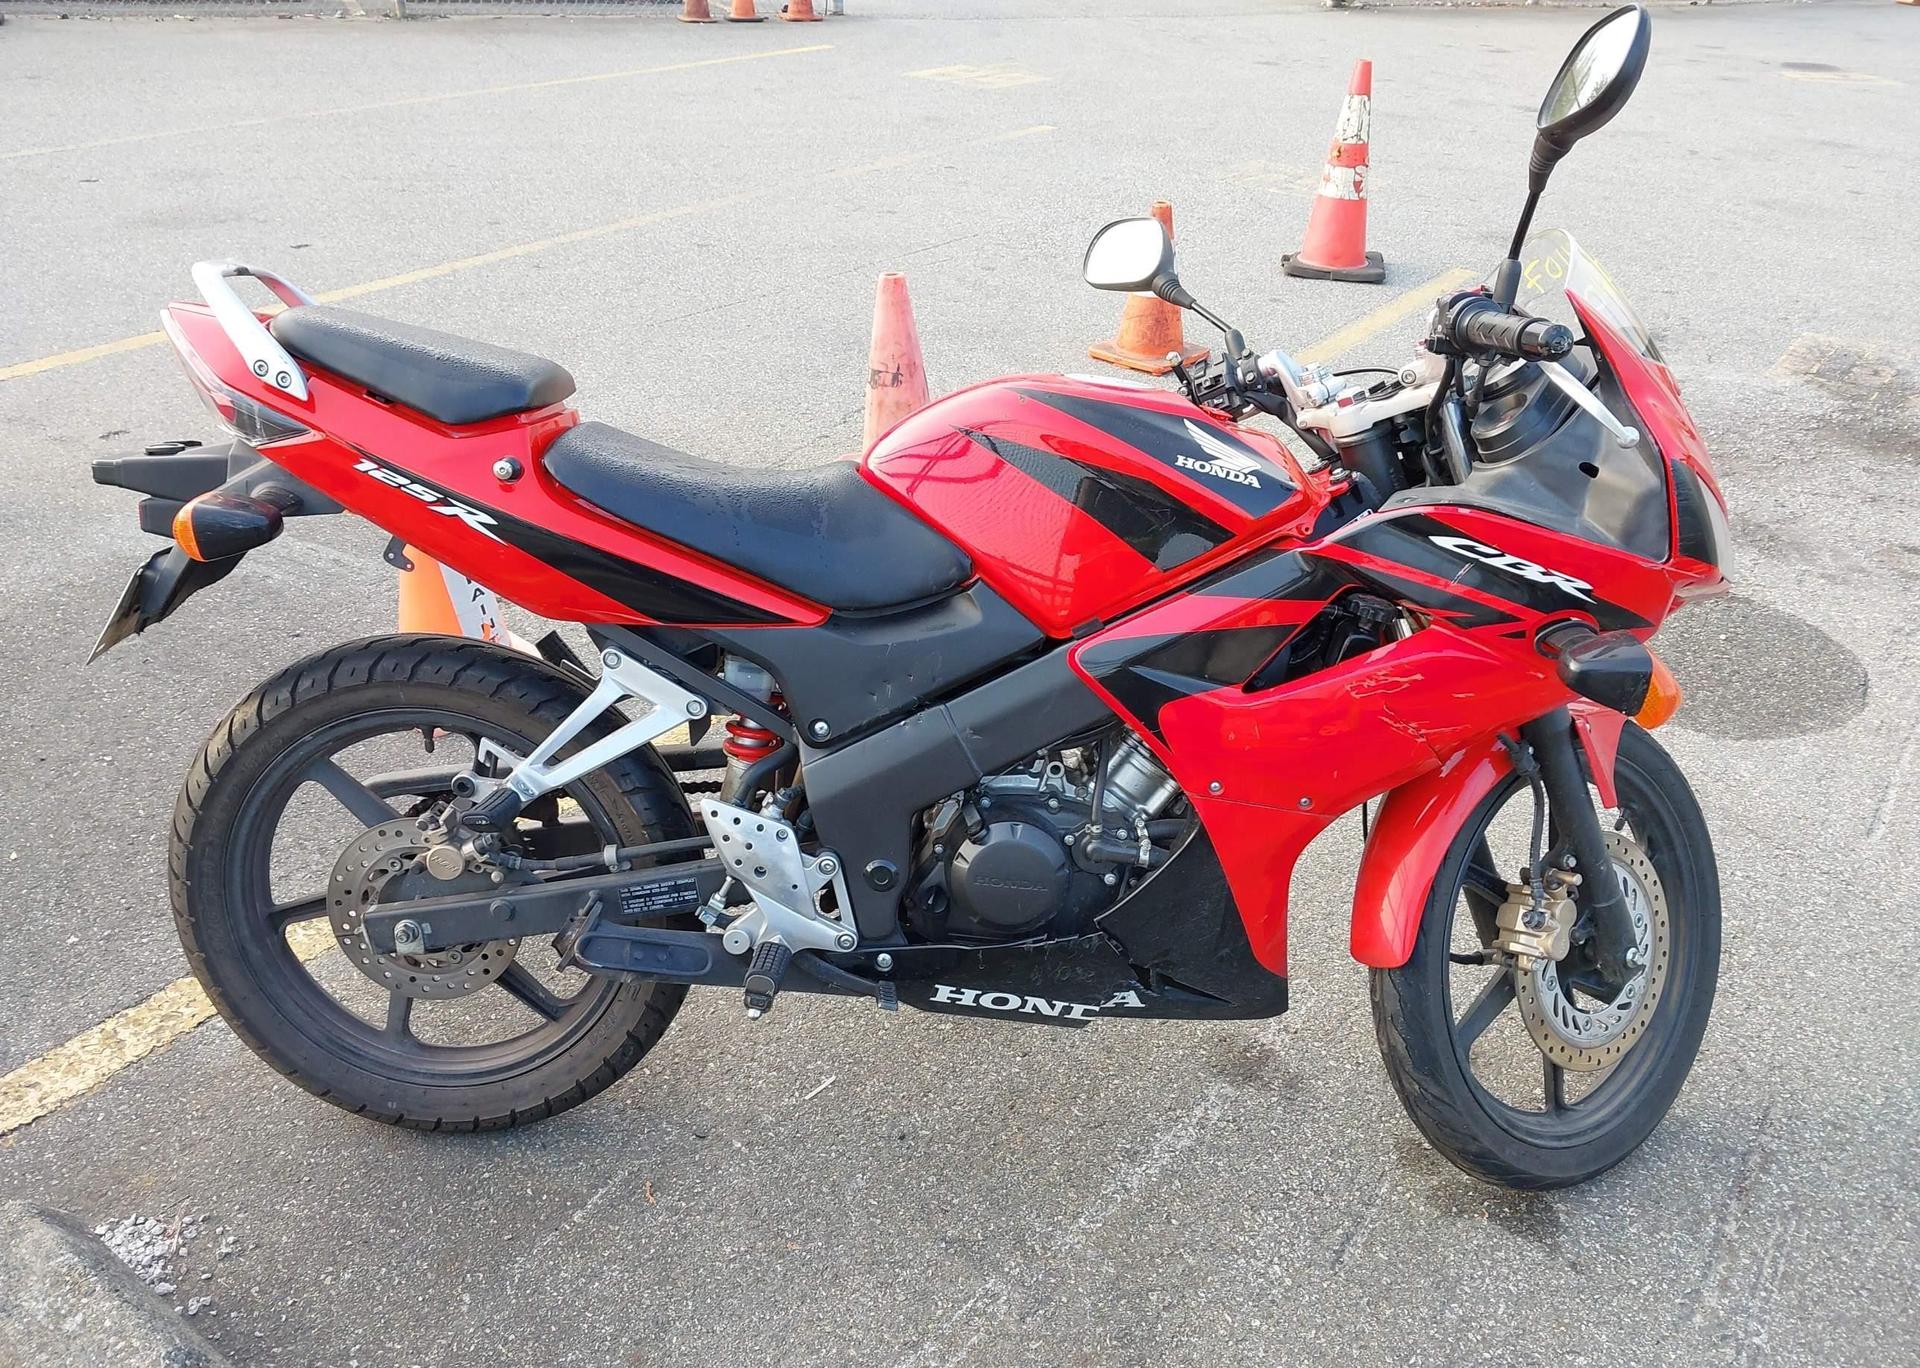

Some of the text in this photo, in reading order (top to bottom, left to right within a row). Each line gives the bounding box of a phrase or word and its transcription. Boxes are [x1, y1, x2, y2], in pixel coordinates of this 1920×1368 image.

[1174, 454, 1262, 489] HONDA
[352, 457, 508, 546] 125R
[1428, 535, 1598, 605] CBR
[974, 874, 1049, 892] HONDA
